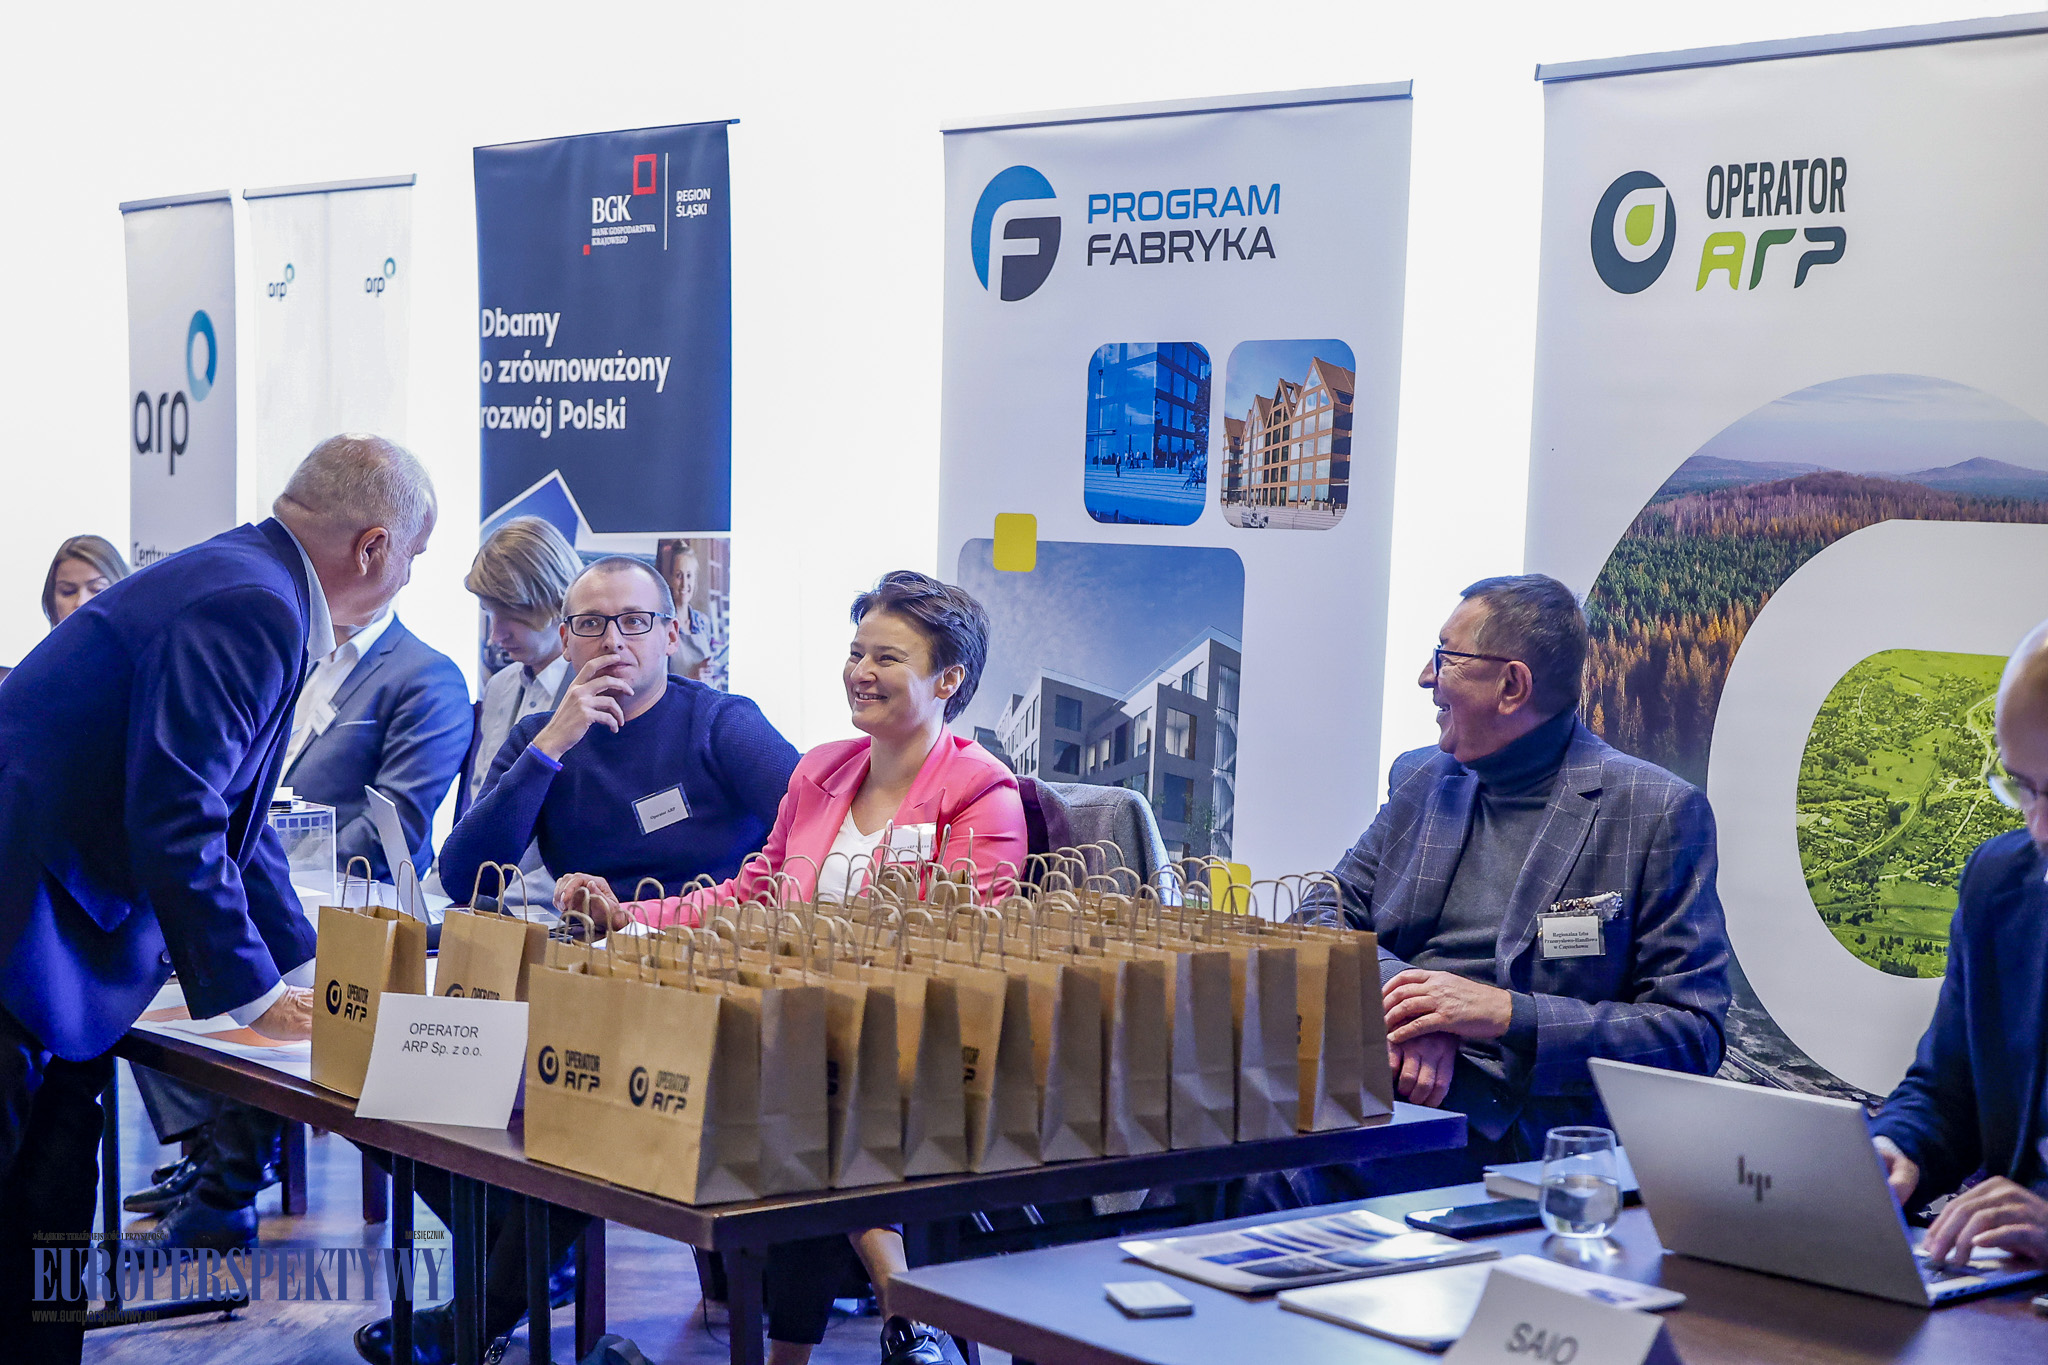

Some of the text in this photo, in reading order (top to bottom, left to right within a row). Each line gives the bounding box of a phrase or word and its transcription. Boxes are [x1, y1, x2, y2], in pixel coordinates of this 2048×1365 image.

[676, 188, 711, 202] REGION
[1706, 156, 1847, 220] OPERATOR
[591, 194, 632, 224] BGK
[675, 202, 708, 218] ŚLĄSKI
[1087, 183, 1281, 224] PROGRAM
[591, 224, 656, 236] BANK GOSPODARSTWA
[1086, 226, 1276, 266] FABRYKA
[268, 281, 288, 301] arp
[365, 277, 386, 298] arp
[481, 307, 561, 348] Dbamy
[481, 349, 671, 393] o zrównoważony
[480, 395, 626, 439] rozwój Polski
[133, 390, 190, 476] arp
[409, 1022, 479, 1038] OPERATOR
[402, 1039, 482, 1057] ARP Sp. z o.o.
[564, 1049, 601, 1072] OPERATOR
